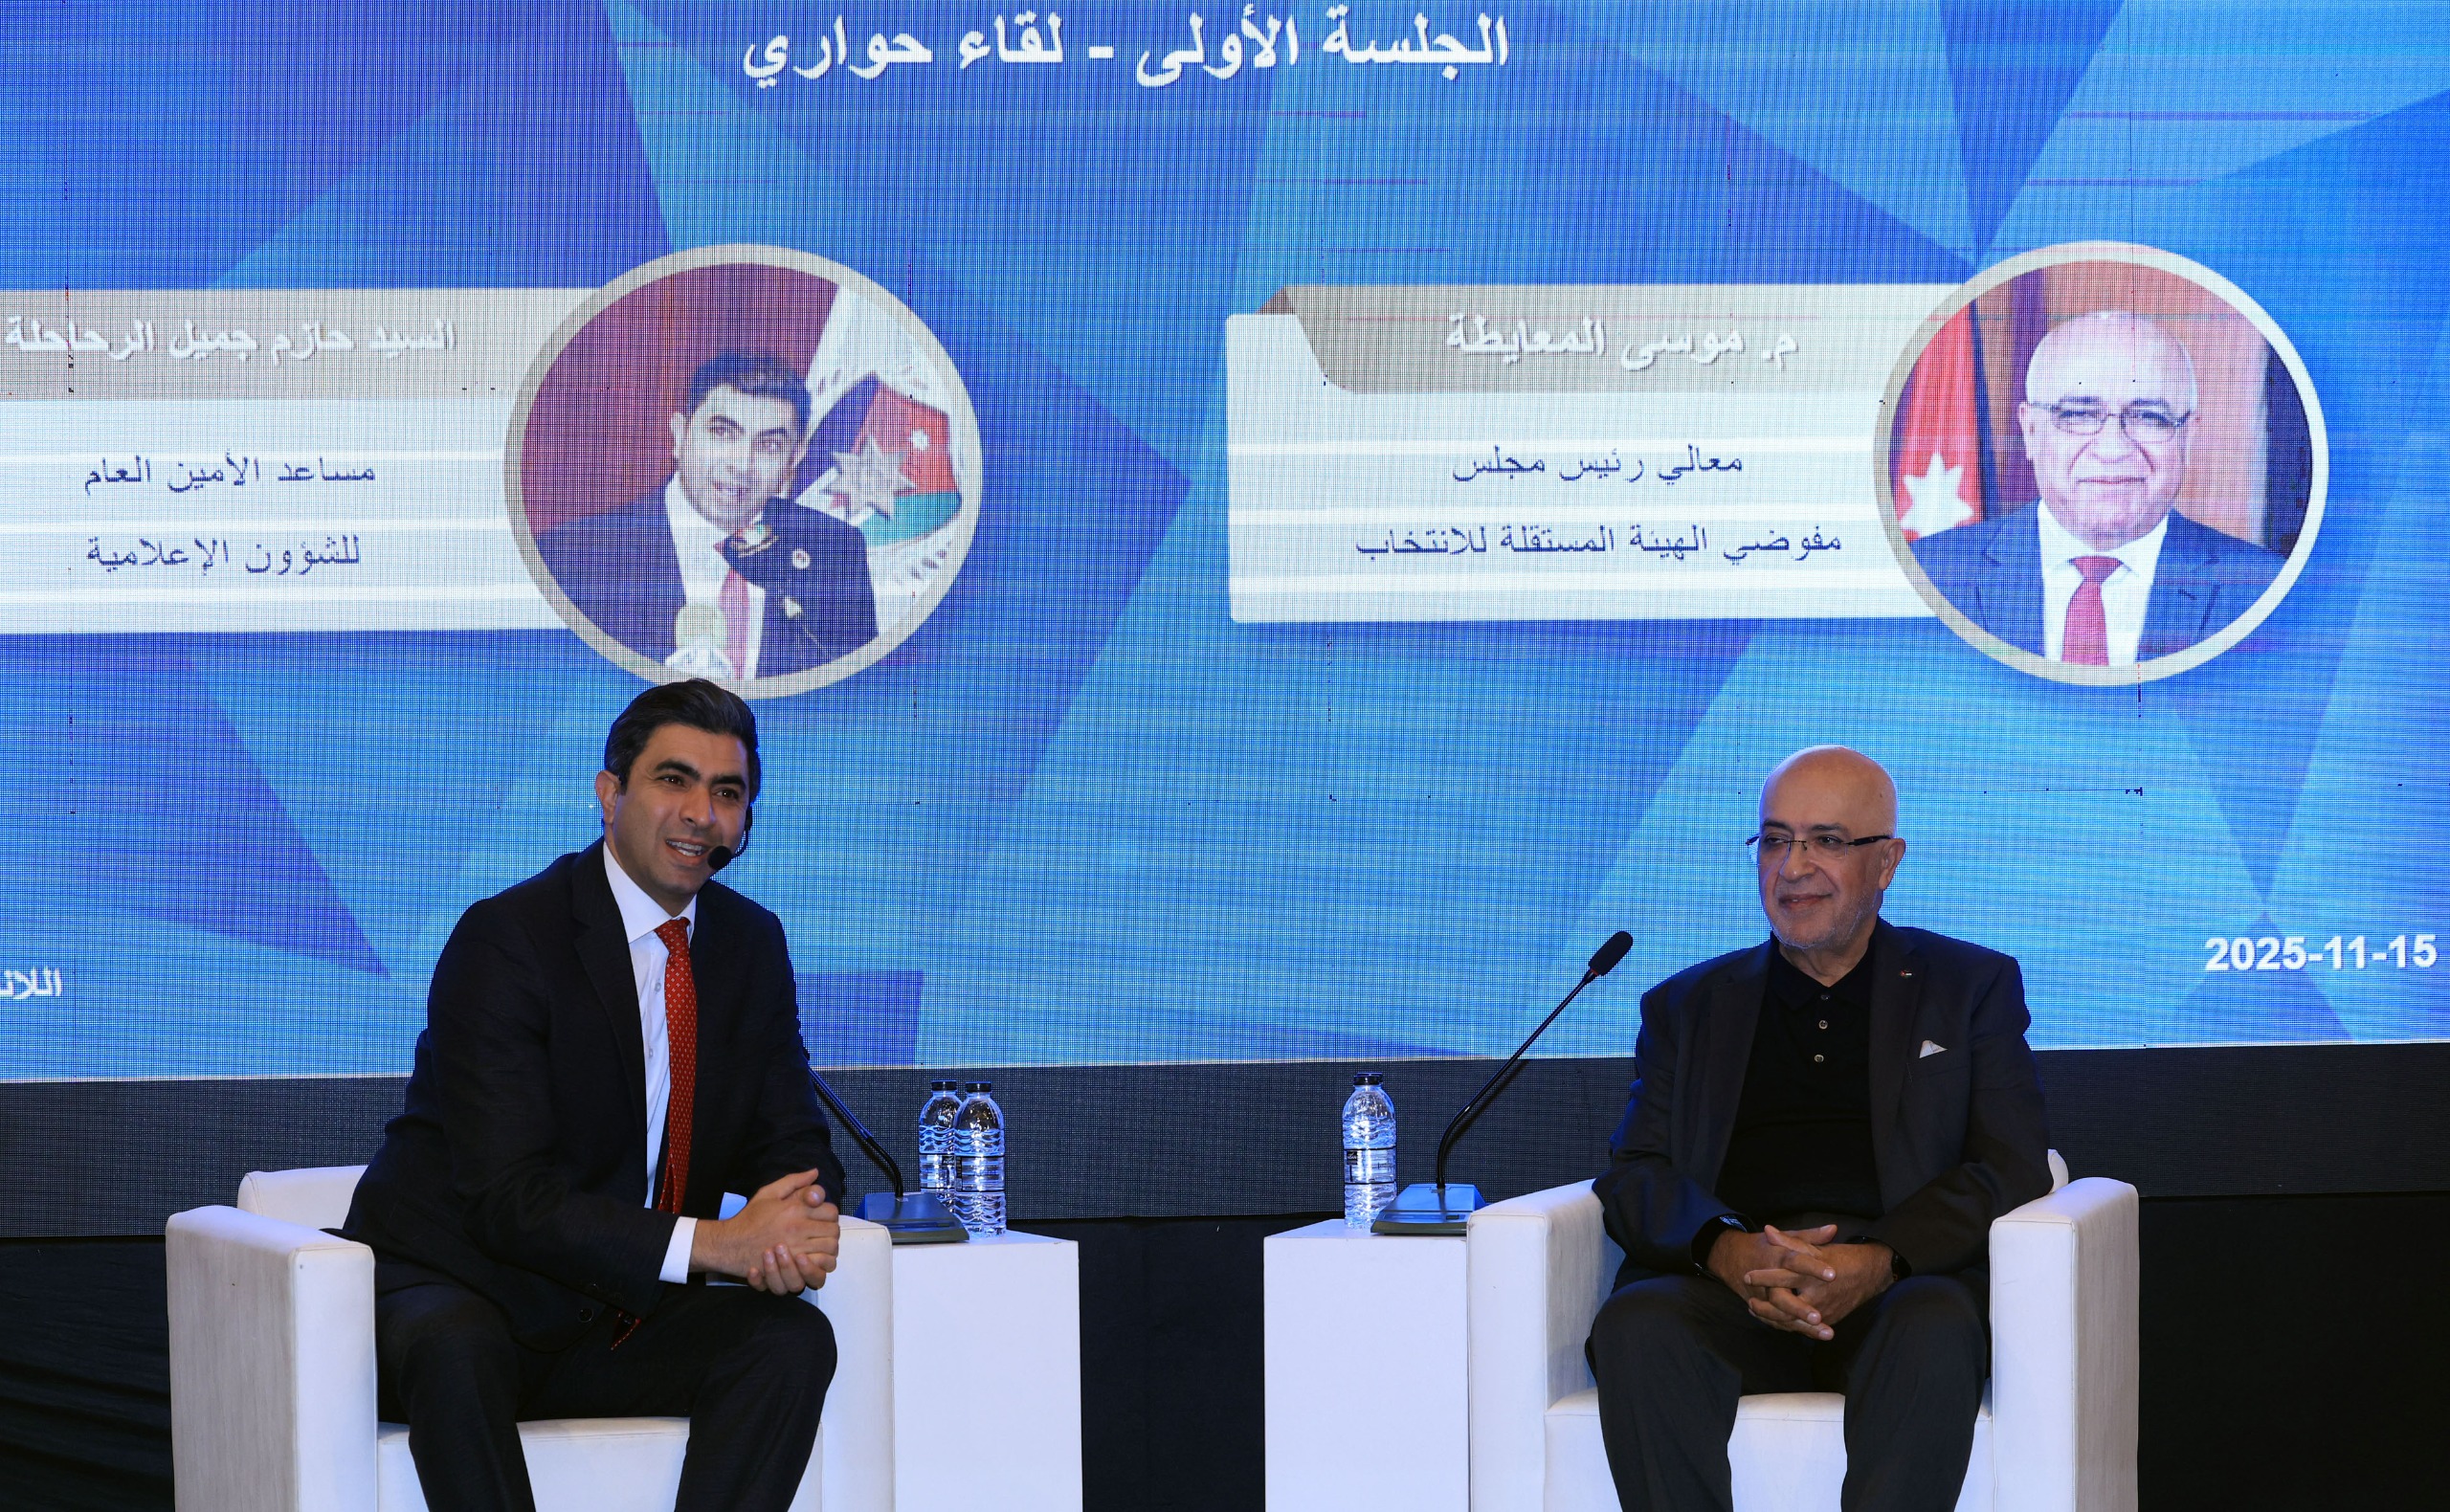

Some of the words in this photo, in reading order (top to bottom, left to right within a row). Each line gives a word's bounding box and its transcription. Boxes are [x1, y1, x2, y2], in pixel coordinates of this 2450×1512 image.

[743, 13, 933, 89] حواري
[959, 10, 1064, 70] لقاء
[1135, 2, 1300, 87] الأولى
[1322, 4, 1509, 80] الجلسة
[4, 315, 156, 361] الرحاحلة
[169, 319, 260, 364] جميل
[271, 321, 356, 367] حازم
[367, 319, 457, 360] السيد
[1446, 312, 1606, 365] المعايطة
[1620, 329, 1747, 372] موسى
[84, 454, 151, 496] العام
[167, 448, 260, 493] الأمين
[277, 456, 376, 482] مساعد
[1452, 443, 1546, 482] مجلس
[1558, 447, 1646, 483] رئيس
[1658, 443, 1743, 485] معالي
[86, 536, 230, 577] الإعلامية
[245, 534, 361, 576] للشؤون
[1355, 524, 1487, 562] للانتخاب
[1500, 524, 1615, 553] المستقلة
[1629, 523, 1708, 561] الهيئة
[1723, 524, 1842, 567] مفوضي
[2203, 933, 2439, 971] 2025-11-15
